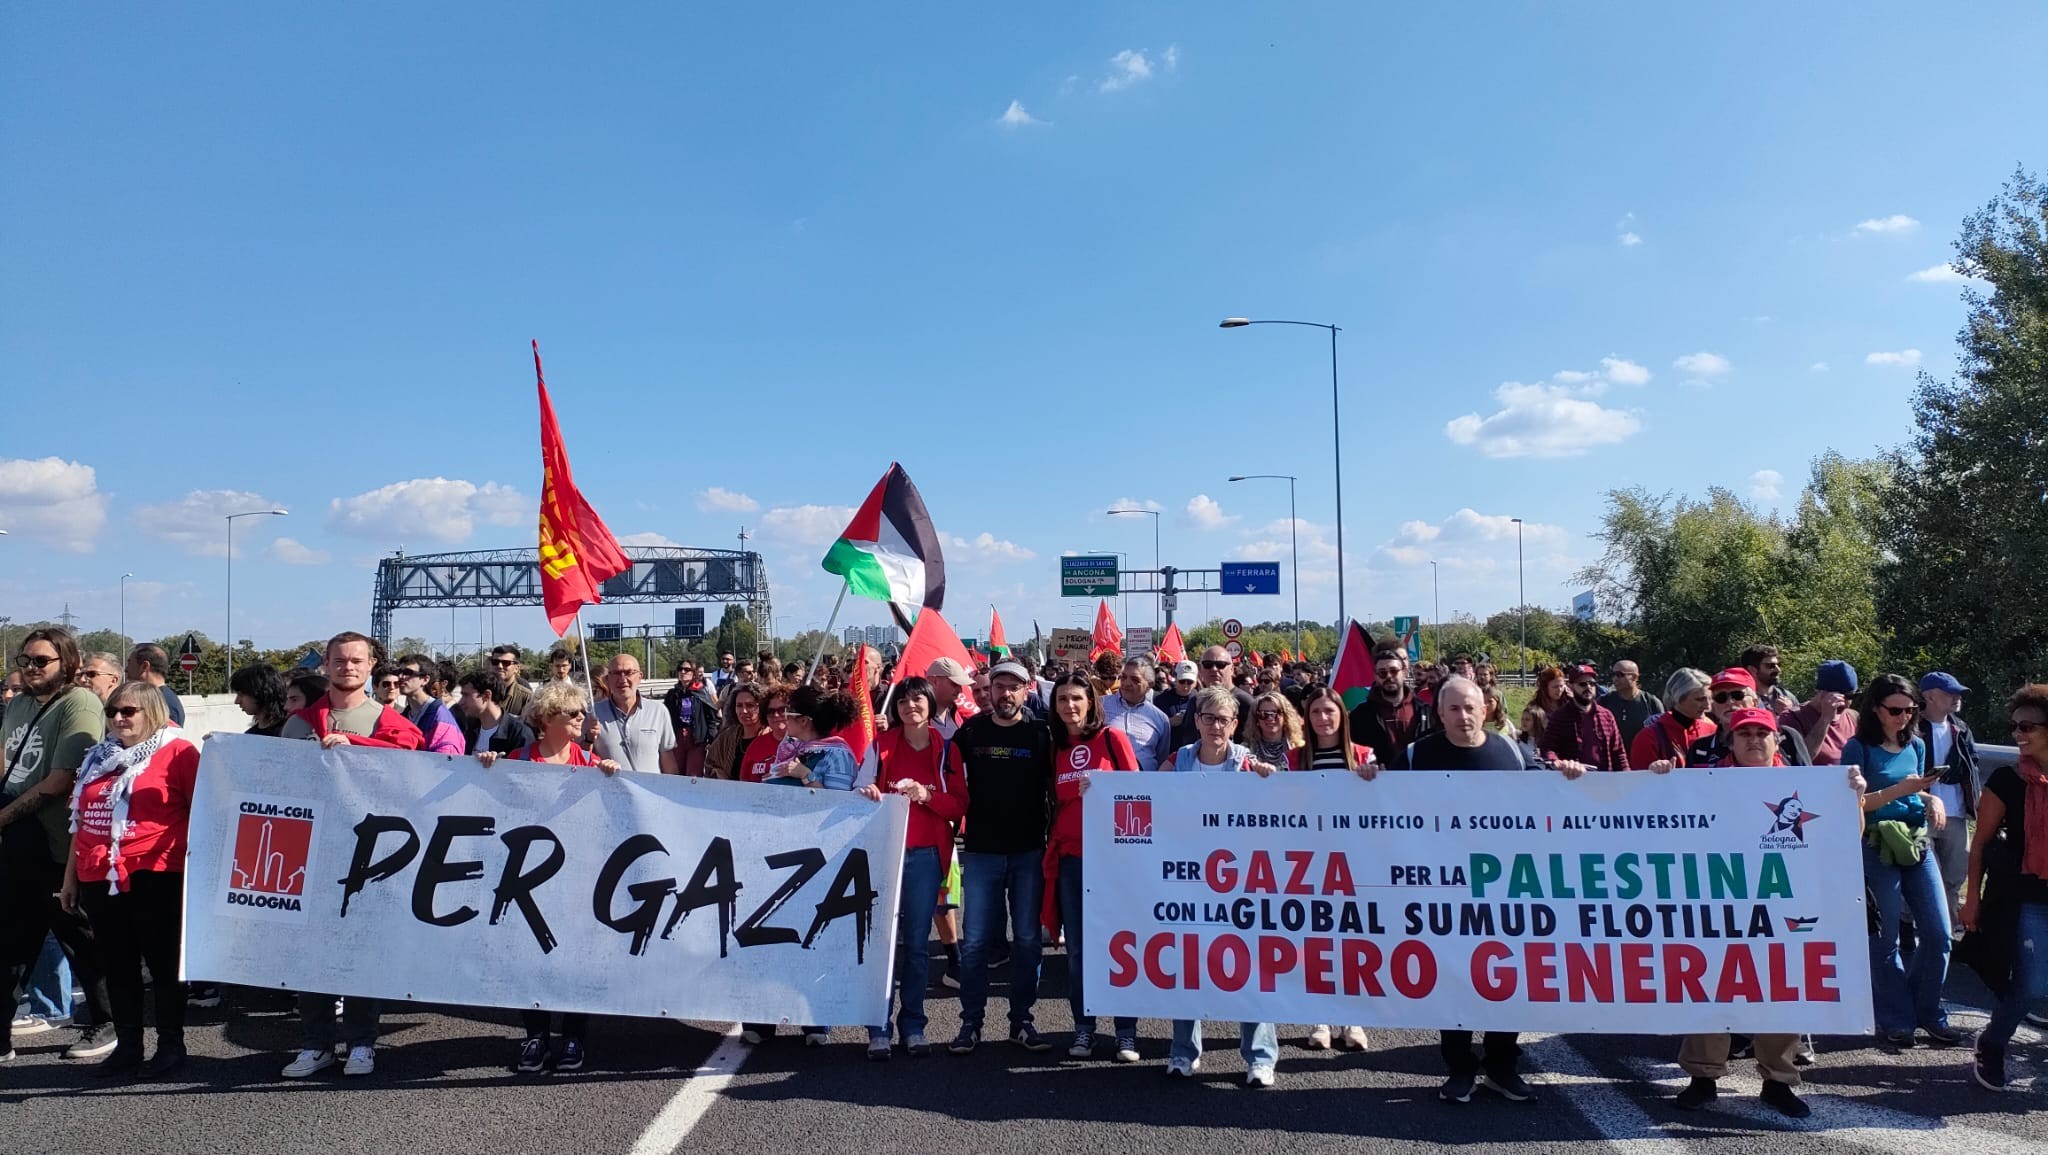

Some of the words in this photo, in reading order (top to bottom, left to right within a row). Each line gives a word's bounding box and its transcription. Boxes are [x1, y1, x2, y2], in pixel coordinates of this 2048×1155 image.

[1236, 569, 1276, 577] FERRARA
[1226, 624, 1239, 634] 40
[240, 802, 315, 819] CDLM-CGIL
[1202, 813, 1219, 827] IN
[1227, 814, 1308, 828] FABBRICA
[1332, 815, 1350, 829] IN
[1358, 815, 1424, 829] UFFICIO
[1450, 815, 1462, 829] A
[1469, 815, 1537, 830] SCUOLA
[1562, 813, 1717, 830] ALL'UNIVERSITA'
[1760, 834, 1797, 844] Bologna
[1162, 861, 1201, 880] PER
[1205, 849, 1357, 896] GAZA
[1390, 865, 1432, 885] PER
[1439, 865, 1467, 885] LA
[1469, 852, 1794, 900] PALESTINA
[337, 812, 566, 955] PER
[592, 833, 879, 965] GAZA
[227, 892, 302, 912] BOLOGNA
[1153, 902, 1196, 922] CON
[1203, 902, 1229, 923] LA
[1231, 897, 1385, 935] GLOBAL
[1404, 902, 1557, 936] SUMUD
[1578, 904, 1775, 938] FLOTILLA
[1108, 930, 1438, 999] SCIOPERO
[1470, 940, 1841, 1003] GENERALE
